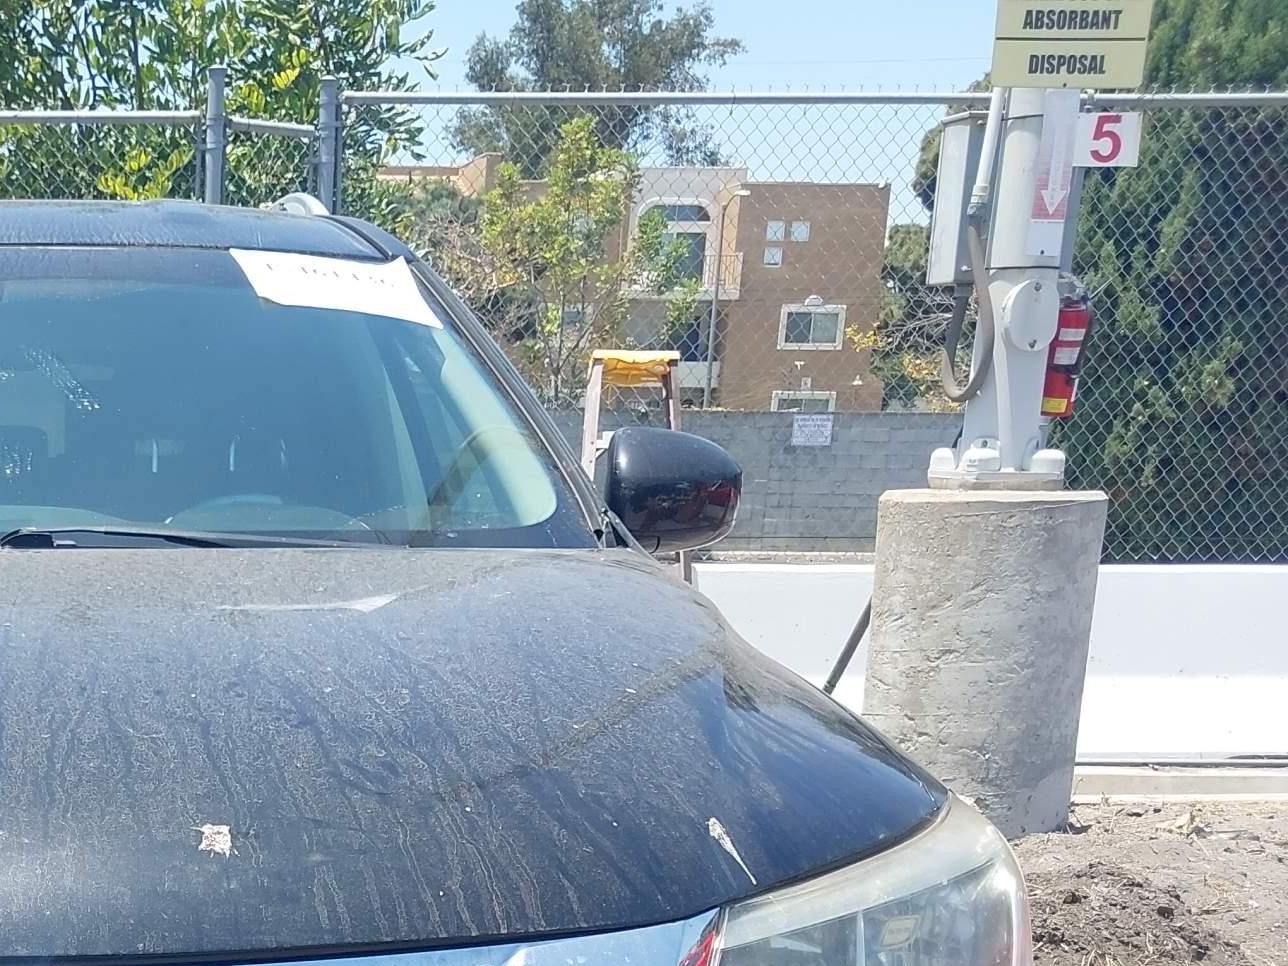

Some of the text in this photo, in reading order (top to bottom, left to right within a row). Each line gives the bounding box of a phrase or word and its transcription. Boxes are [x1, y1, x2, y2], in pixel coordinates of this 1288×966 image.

[1022, 9, 1123, 30] ABSORBANT
[1028, 54, 1106, 75] DISPOSAL
[1089, 114, 1123, 164] 5
